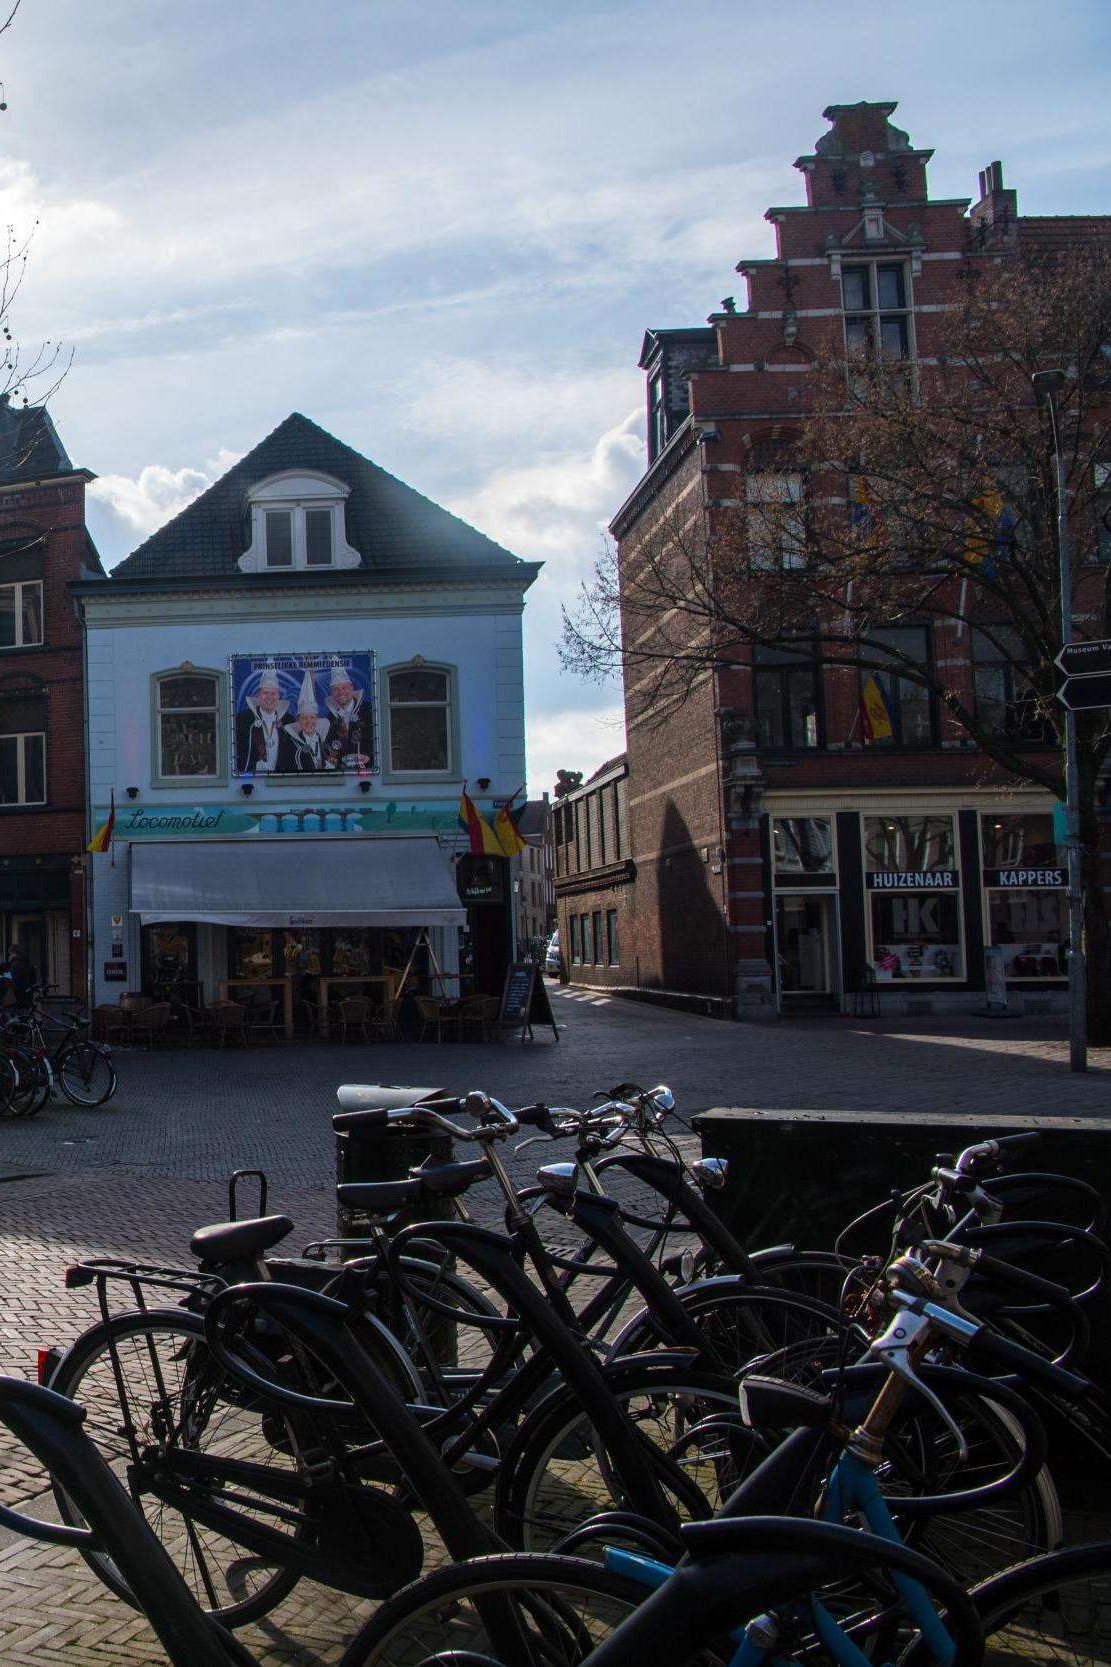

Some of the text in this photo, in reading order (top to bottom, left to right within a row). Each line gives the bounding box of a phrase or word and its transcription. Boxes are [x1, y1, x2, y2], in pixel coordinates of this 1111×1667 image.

[1067, 646, 1099, 655] Museum
[126, 808, 225, 829] Locomotief
[873, 870, 1063, 888] HUIZENAAR KAPPERS
[892, 896, 940, 933] HK
